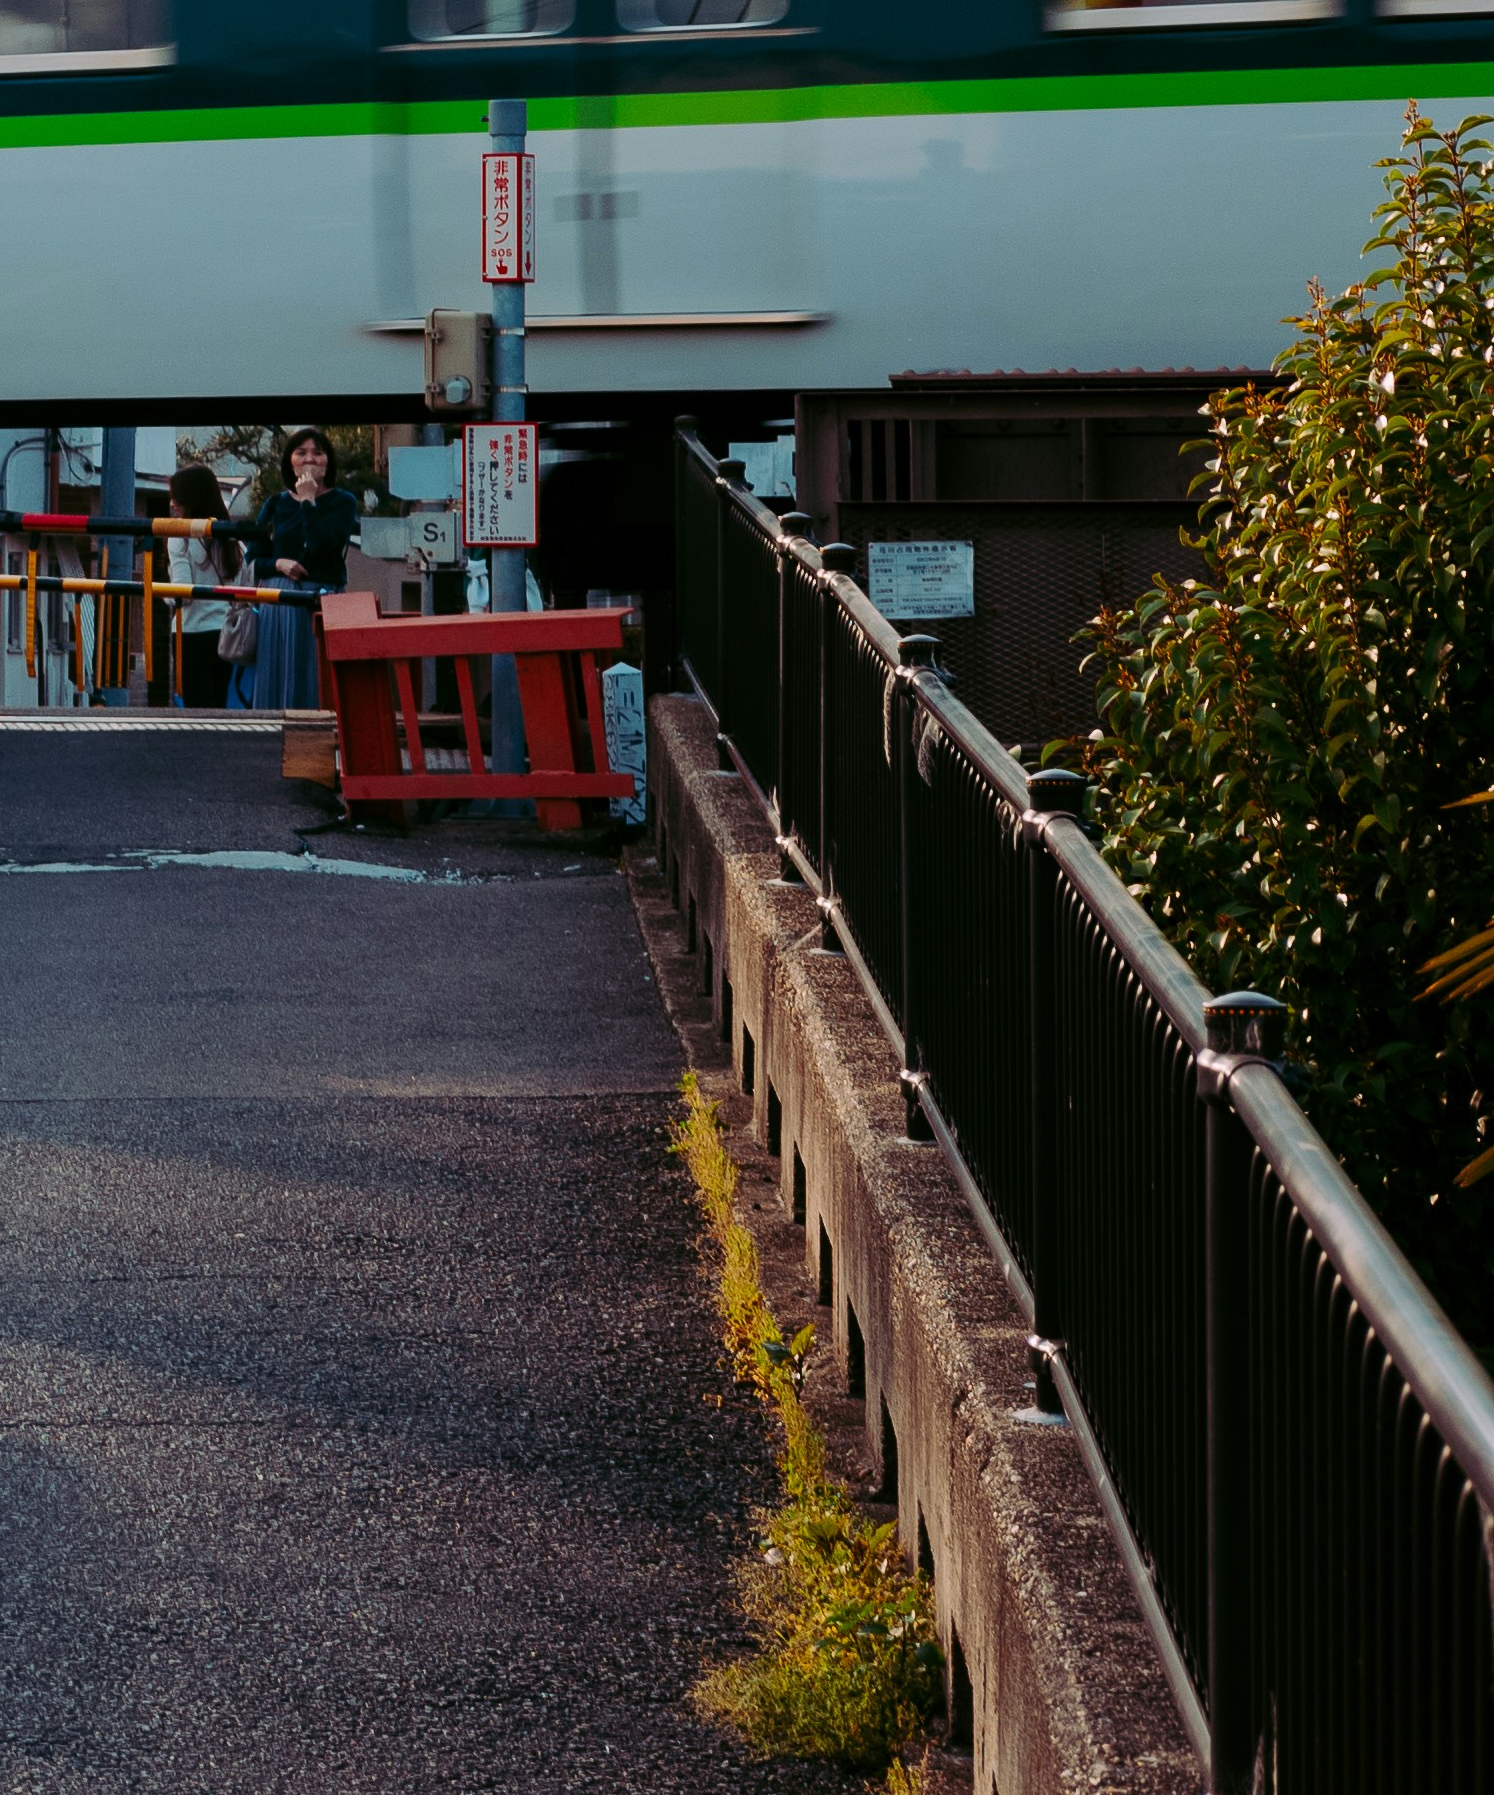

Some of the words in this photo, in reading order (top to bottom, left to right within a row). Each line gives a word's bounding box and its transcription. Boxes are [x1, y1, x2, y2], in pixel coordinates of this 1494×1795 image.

[493, 160, 509, 244] 非常ボタン
[490, 248, 512, 257] SOS
